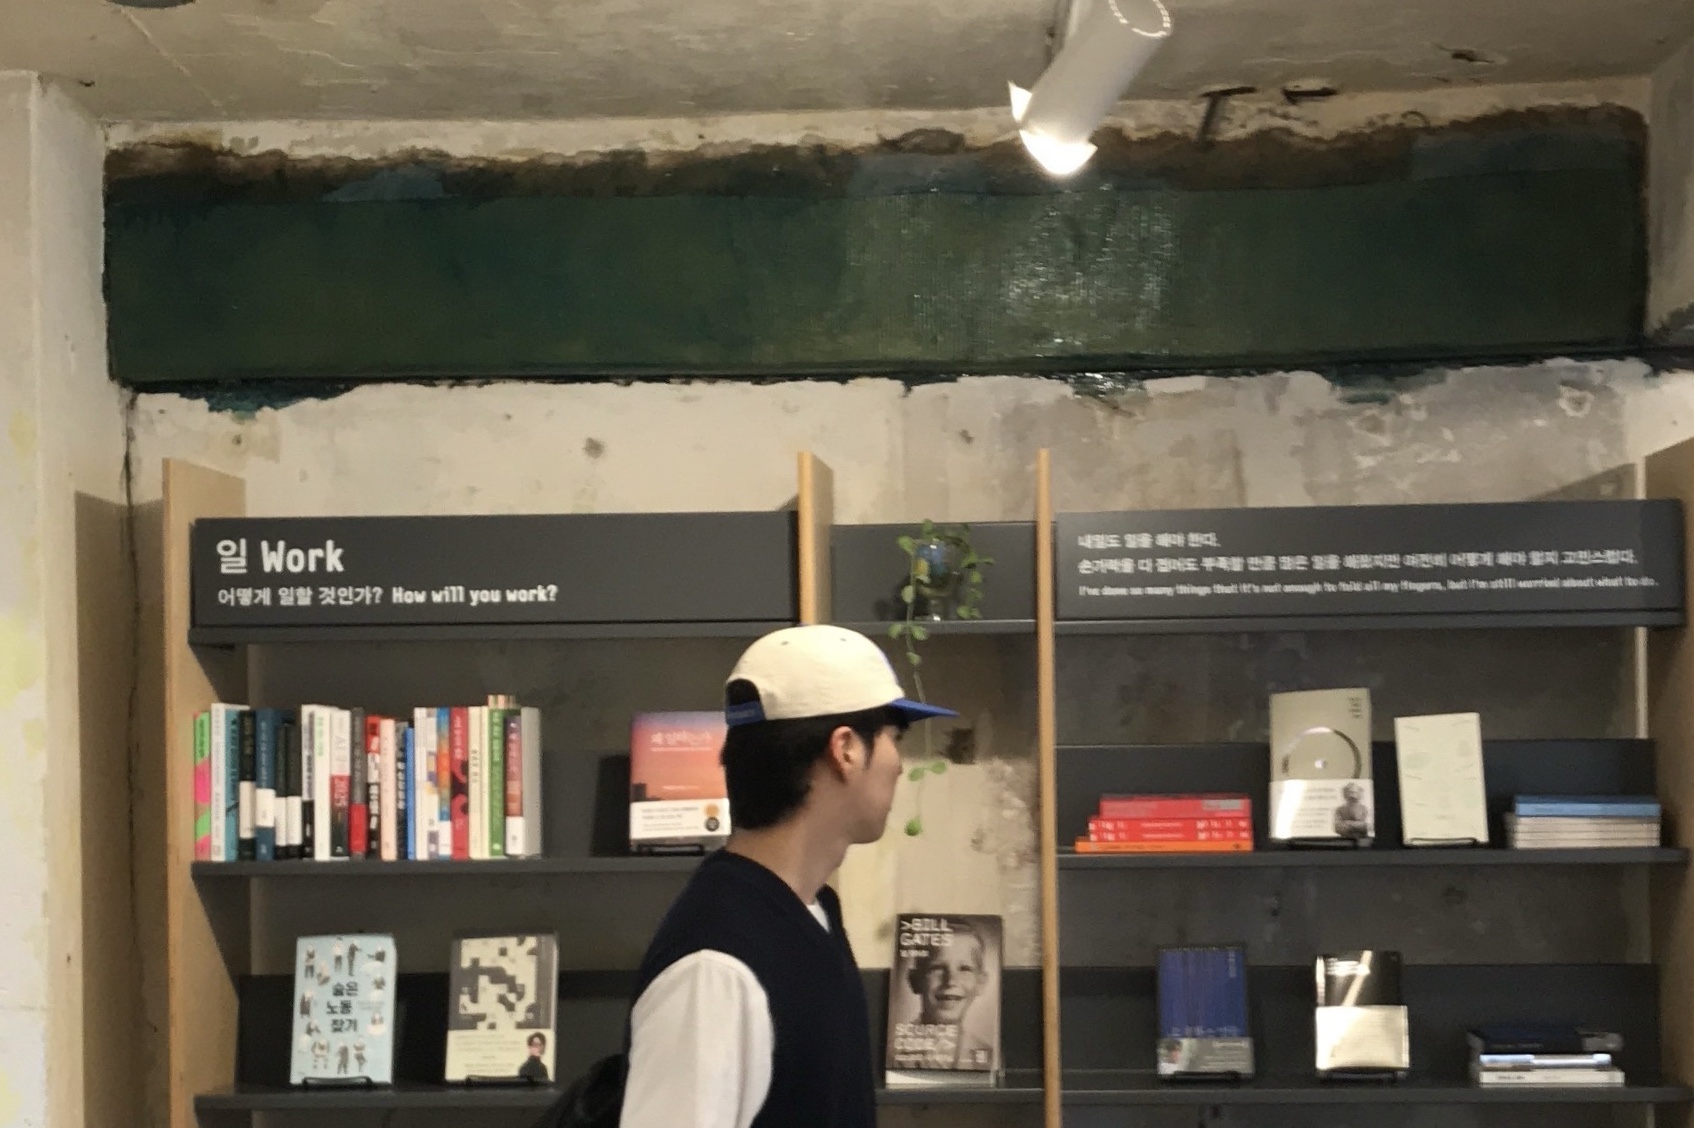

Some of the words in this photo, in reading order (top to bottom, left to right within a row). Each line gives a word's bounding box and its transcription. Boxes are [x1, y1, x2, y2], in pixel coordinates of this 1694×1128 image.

[1078, 534, 1121, 548] 내일도
[1124, 533, 1153, 548] 일을
[1187, 532, 1220, 547] 한다.
[217, 538, 247, 573] 일
[261, 540, 344, 573] Work
[218, 587, 271, 606] 어떻게
[278, 587, 313, 606] 일할
[319, 586, 383, 605] 것인가?
[392, 587, 424, 603] How
[432, 586, 464, 602] will
[470, 590, 501, 606] you
[506, 585, 557, 602] work?
[900, 933, 954, 946] GATES
[327, 1000, 352, 1015] 노동
[332, 1018, 358, 1033] 찾기
[895, 1023, 957, 1036] SOURCE
